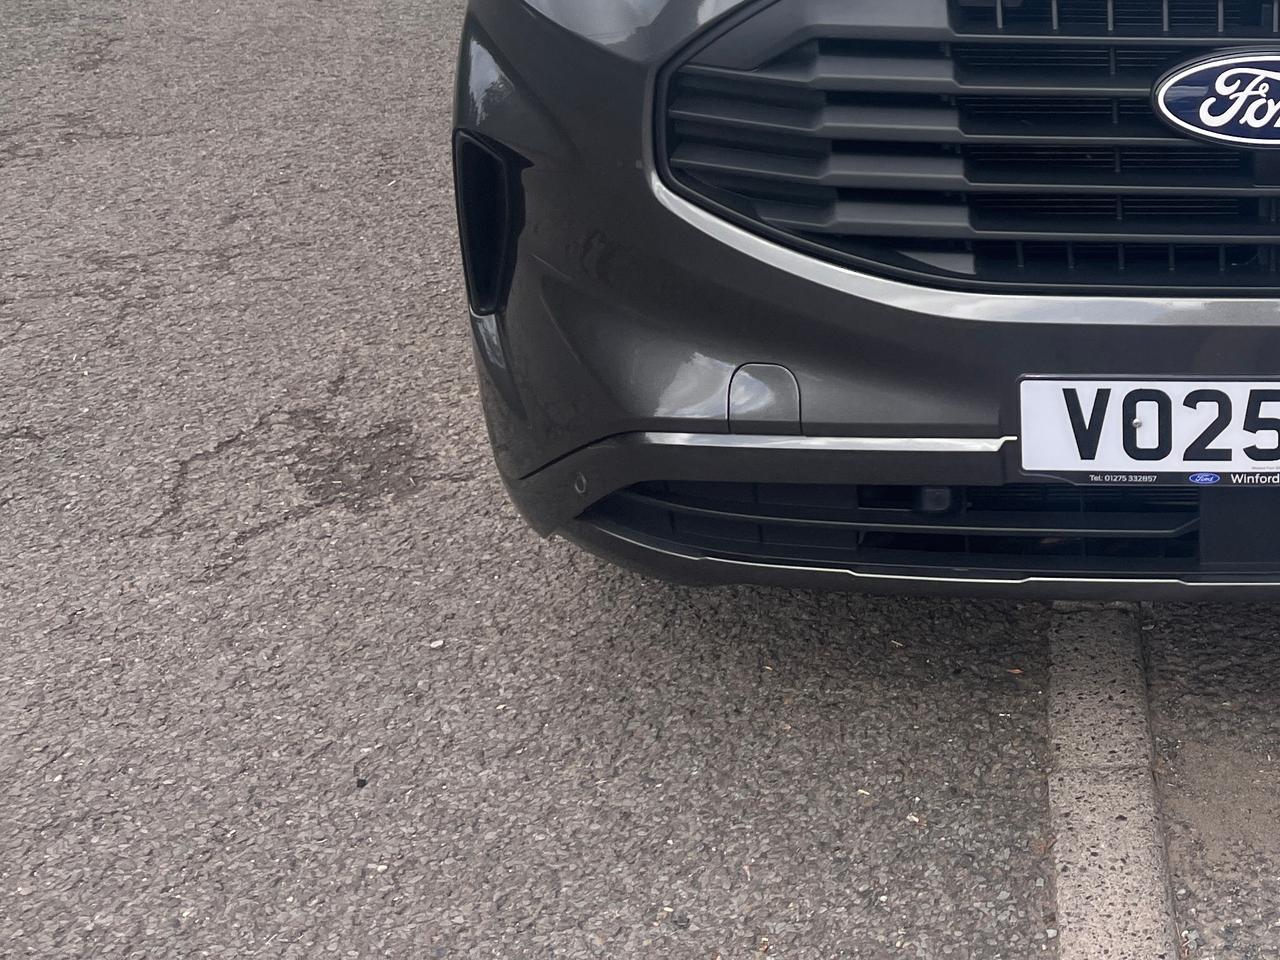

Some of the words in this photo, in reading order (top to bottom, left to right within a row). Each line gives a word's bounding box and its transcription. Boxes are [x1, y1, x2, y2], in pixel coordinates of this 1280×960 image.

[1104, 474, 1127, 482] 01275
[1128, 474, 1157, 482] 332857
[1230, 473, 1280, 484] Winford
